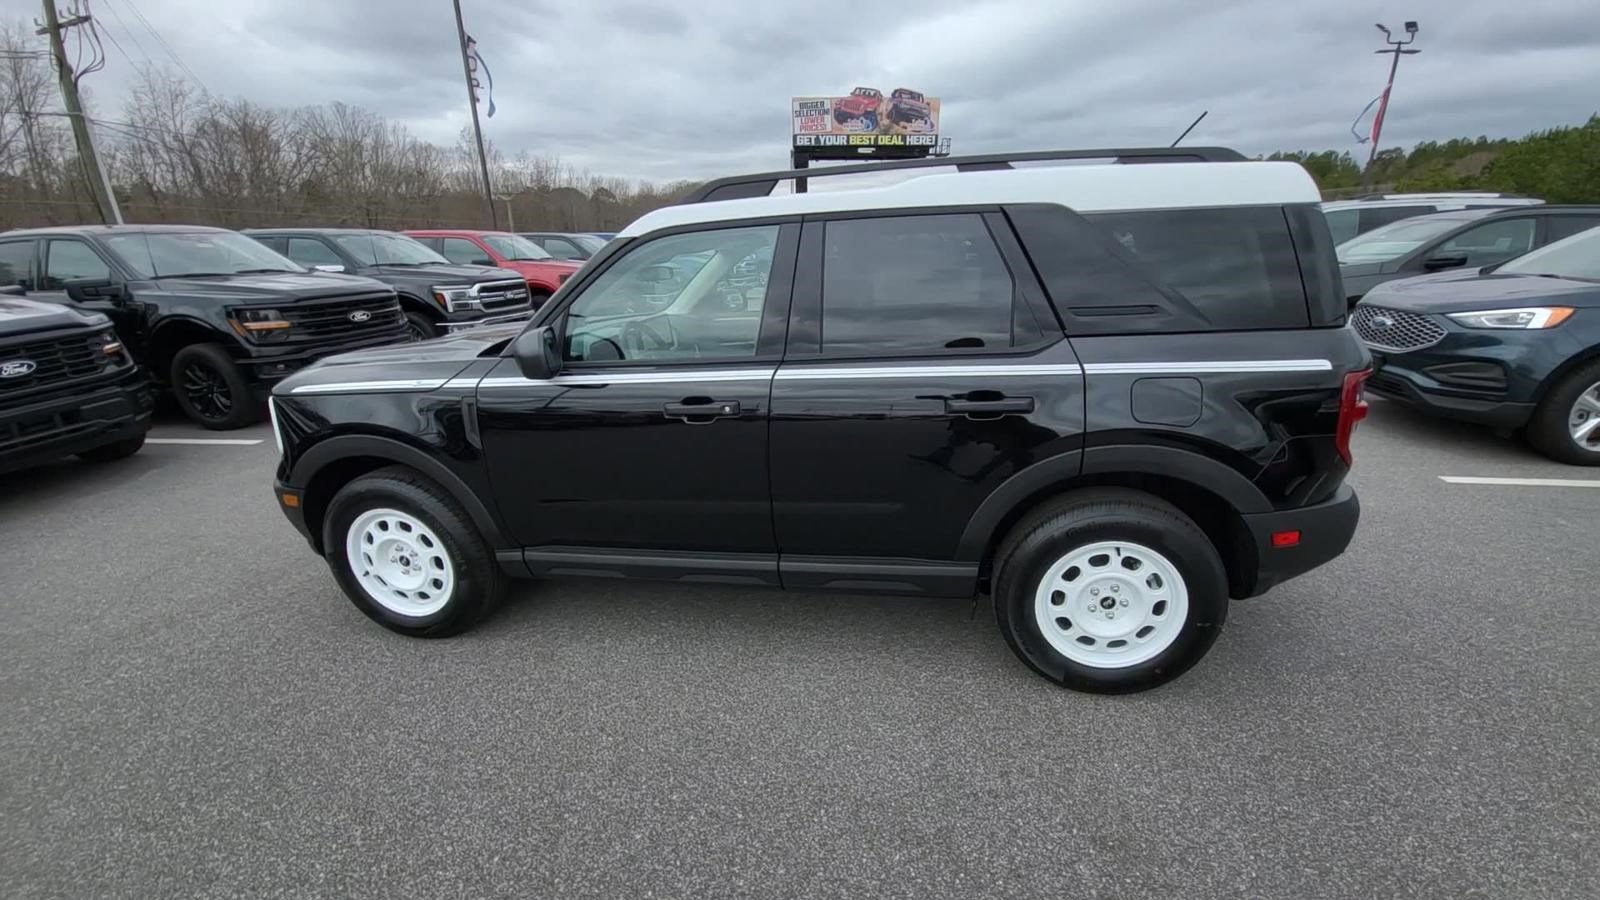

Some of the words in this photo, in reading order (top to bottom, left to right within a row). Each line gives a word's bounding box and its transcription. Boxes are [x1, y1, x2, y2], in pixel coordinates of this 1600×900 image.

[799, 101, 825, 110] BIGGER
[800, 116, 825, 125] LOWER
[796, 135, 817, 145] GET
[819, 135, 847, 145] YOUR
[849, 135, 877, 145] BEST
[878, 135, 904, 145] DEAL
[906, 135, 936, 145] HERE!
